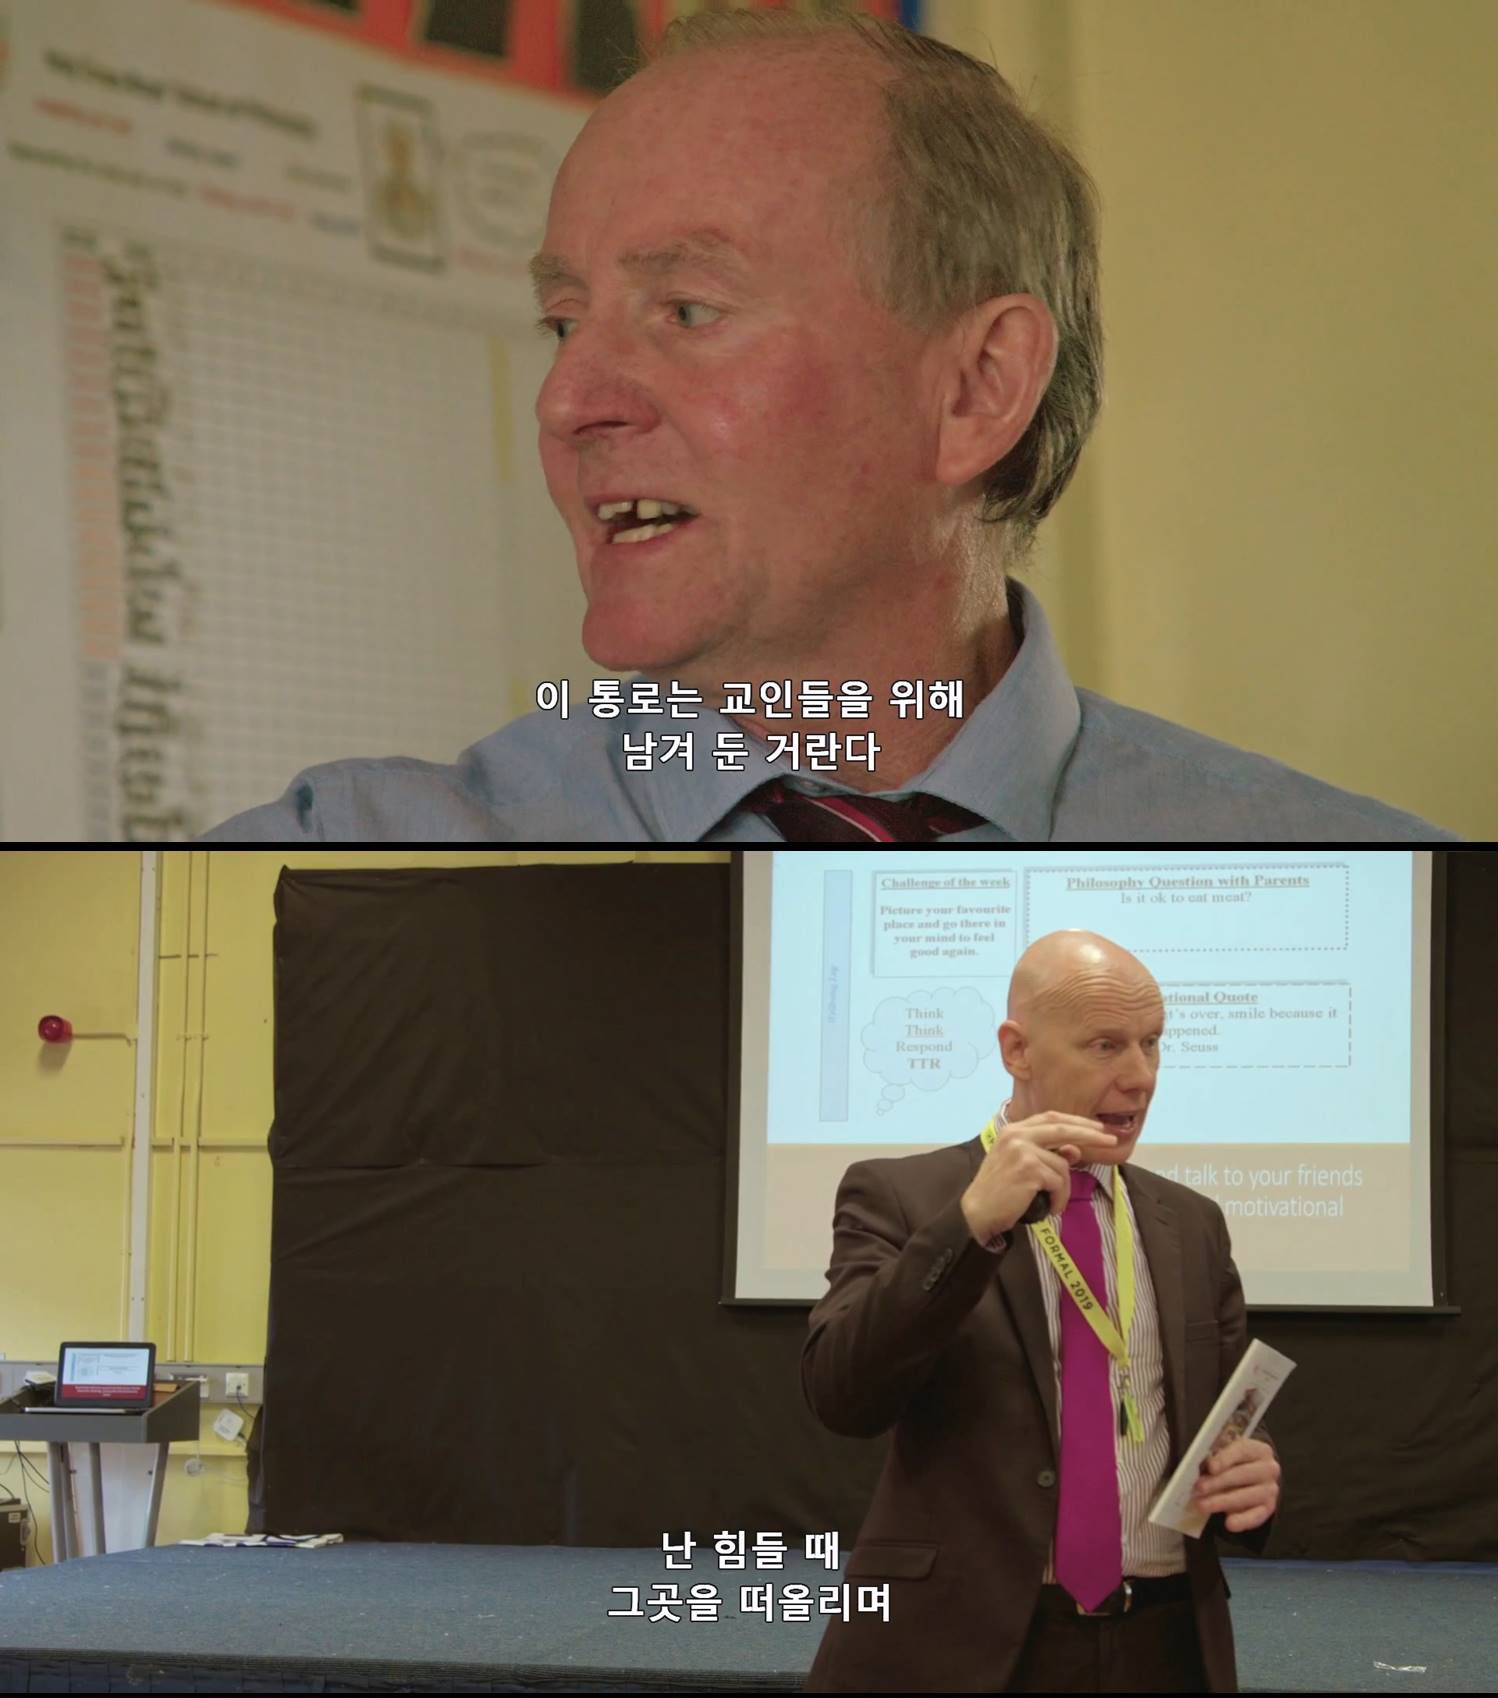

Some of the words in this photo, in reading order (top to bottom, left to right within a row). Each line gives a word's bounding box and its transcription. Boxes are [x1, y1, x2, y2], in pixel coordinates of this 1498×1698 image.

[881, 878, 941, 890] Challenge
[943, 878, 956, 889] of
[958, 877, 977, 889] the
[979, 877, 1010, 888] week
[1066, 877, 1144, 890] Philosophy
[1149, 876, 1213, 889] Question
[1217, 875, 1250, 888] with
[1254, 875, 1310, 887] Parents
[1120, 892, 1133, 904] Is
[1137, 892, 1146, 904] it
[1149, 891, 1167, 904] ok
[1171, 893, 1184, 904] to
[1188, 893, 1208, 903] eat
[1211, 891, 1252, 903] meat?
[880, 906, 923, 916] Picture
[925, 906, 953, 917] your
[956, 904, 1011, 914] favourite
[884, 919, 914, 931] place
[917, 919, 940, 928] and
[943, 920, 957, 930] go
[960, 919, 991, 928] there
[994, 919, 1006, 928] in
[893, 934, 923, 945] your
[925, 933, 956, 943] mind
[958, 933, 971, 943] to
[973, 932, 995, 942] feel
[910, 947, 939, 959] good
[942, 947, 979, 958] again.
[1164, 991, 1209, 1004] tional
[1213, 991, 1258, 1004] Quote
[905, 1007, 944, 1020] Think
[1190, 1010, 1224, 1020] over,
[1228, 1008, 1265, 1018] smile
[1270, 1008, 1323, 1018] because
[1328, 1007, 1337, 1018] it
[905, 1024, 944, 1037] Think
[896, 1041, 953, 1054] Respond
[1180, 1041, 1218, 1052] Seuss
[907, 1058, 941, 1069] TTR
[1184, 1163, 1217, 1186] talk
[1224, 1166, 1243, 1187] to
[1249, 1169, 1292, 1191] your
[1297, 1162, 1363, 1187] friends
[1224, 1195, 1344, 1217] motivational
[1041, 1228, 1073, 1279] FORMAL
[1070, 1281, 1093, 1310] 2019
